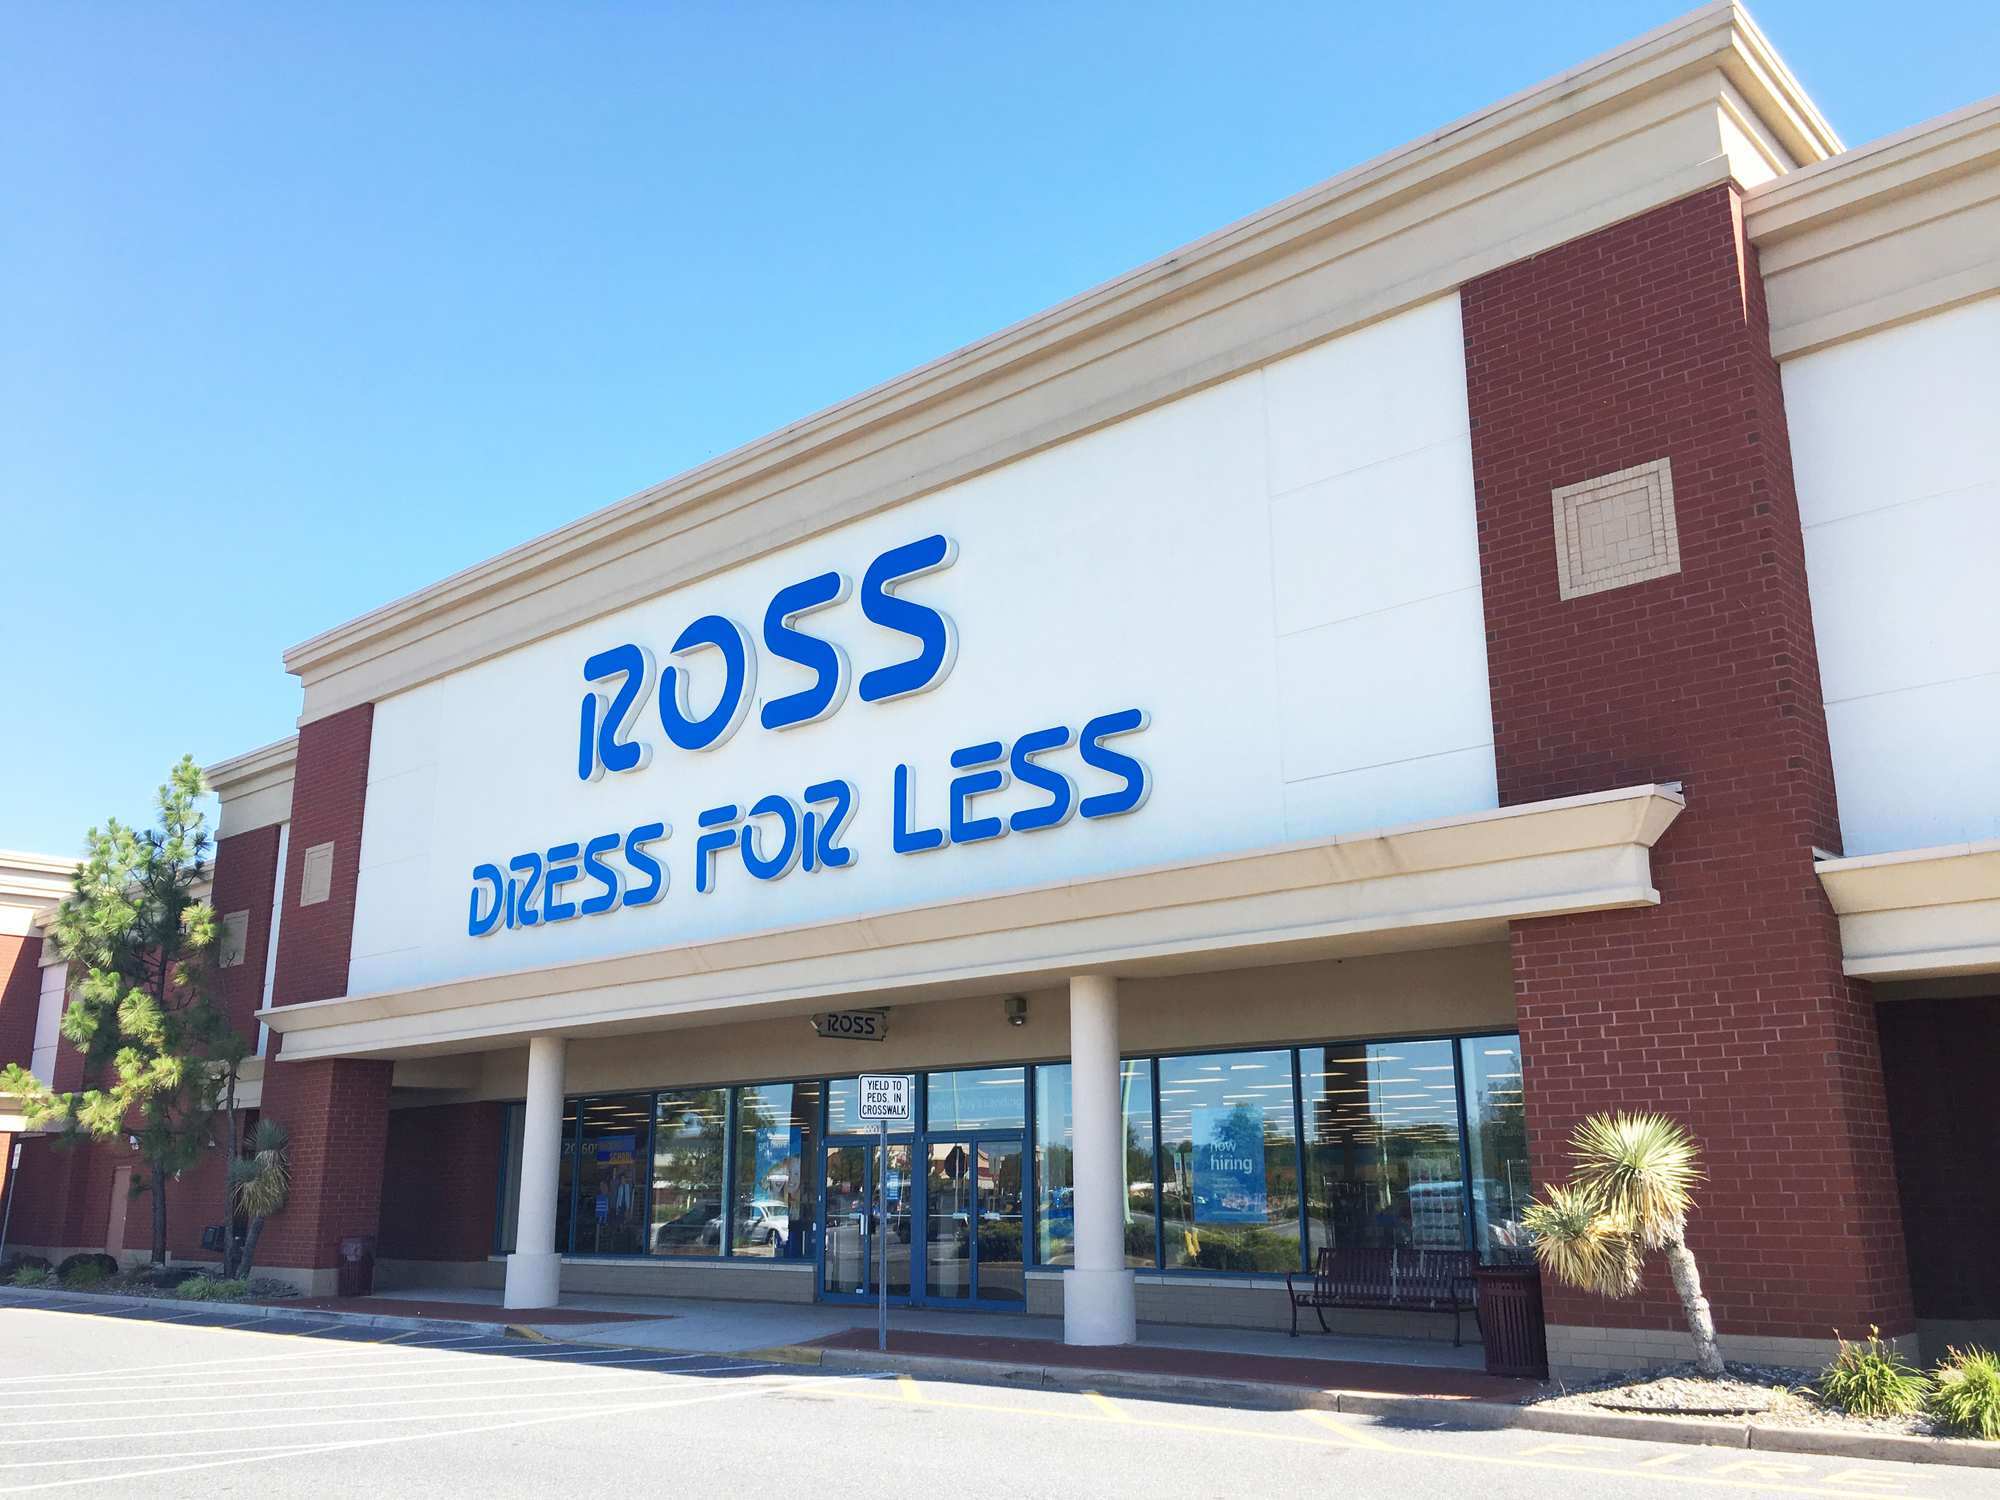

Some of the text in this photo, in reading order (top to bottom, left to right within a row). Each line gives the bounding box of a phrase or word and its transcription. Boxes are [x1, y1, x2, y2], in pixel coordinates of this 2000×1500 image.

[578, 534, 959, 781] ROSS
[468, 708, 1152, 938] DRESS FOR LESS
[827, 1014, 875, 1034] ROSS
[867, 1080, 902, 1091] YIELD TO
[893, 1093, 902, 1103] IN
[862, 1105, 906, 1115] CROSSWALK
[1210, 1141, 1237, 1153] now
[1210, 1154, 1253, 1175] hiring
[1518, 1444, 1935, 1489] FIRE
